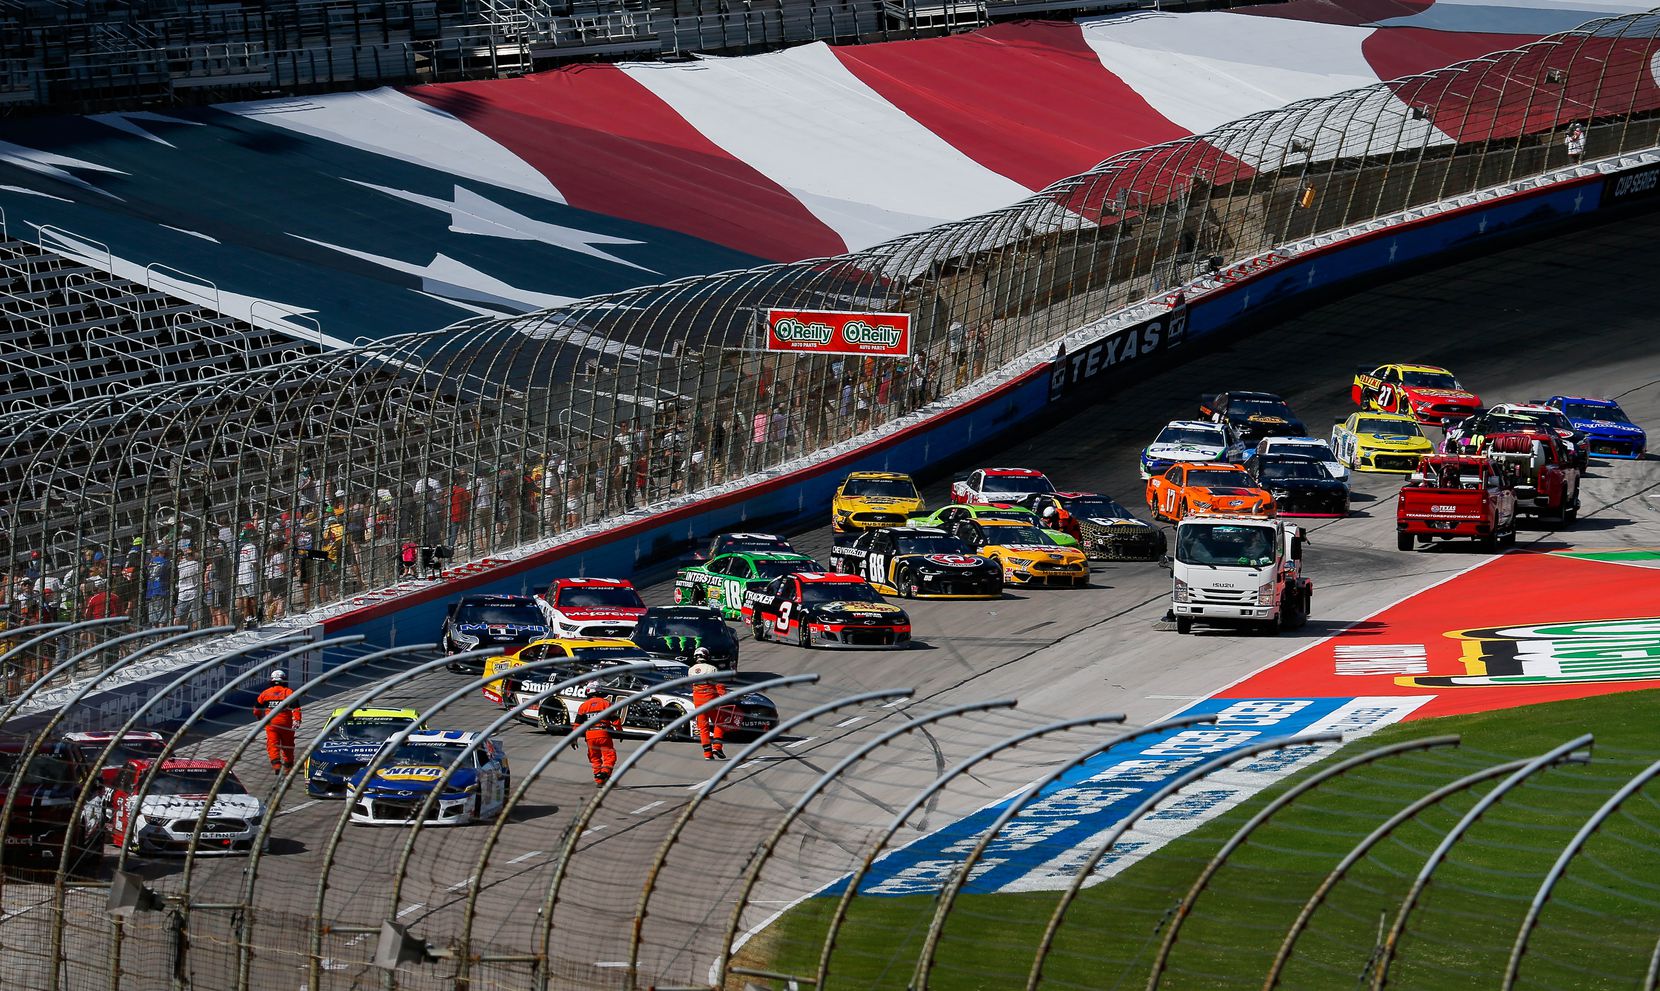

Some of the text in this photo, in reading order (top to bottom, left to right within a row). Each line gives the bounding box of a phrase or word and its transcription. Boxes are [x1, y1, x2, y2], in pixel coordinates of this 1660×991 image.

[1615, 169, 1660, 197] CUP SERIES
[775, 318, 834, 344] O'Reilly
[843, 321, 903, 348] O'Reilly
[1072, 322, 1162, 383] TEXAS
[1378, 386, 1392, 406] 27
[1166, 488, 1176, 513] 17
[685, 571, 723, 586] INTERSTATE
[870, 553, 885, 583] 88
[724, 579, 742, 610] 18
[745, 590, 775, 605] TRACKER
[776, 601, 793, 630] 3
[521, 680, 588, 698] Smiteld
[386, 767, 441, 776] NAPA
